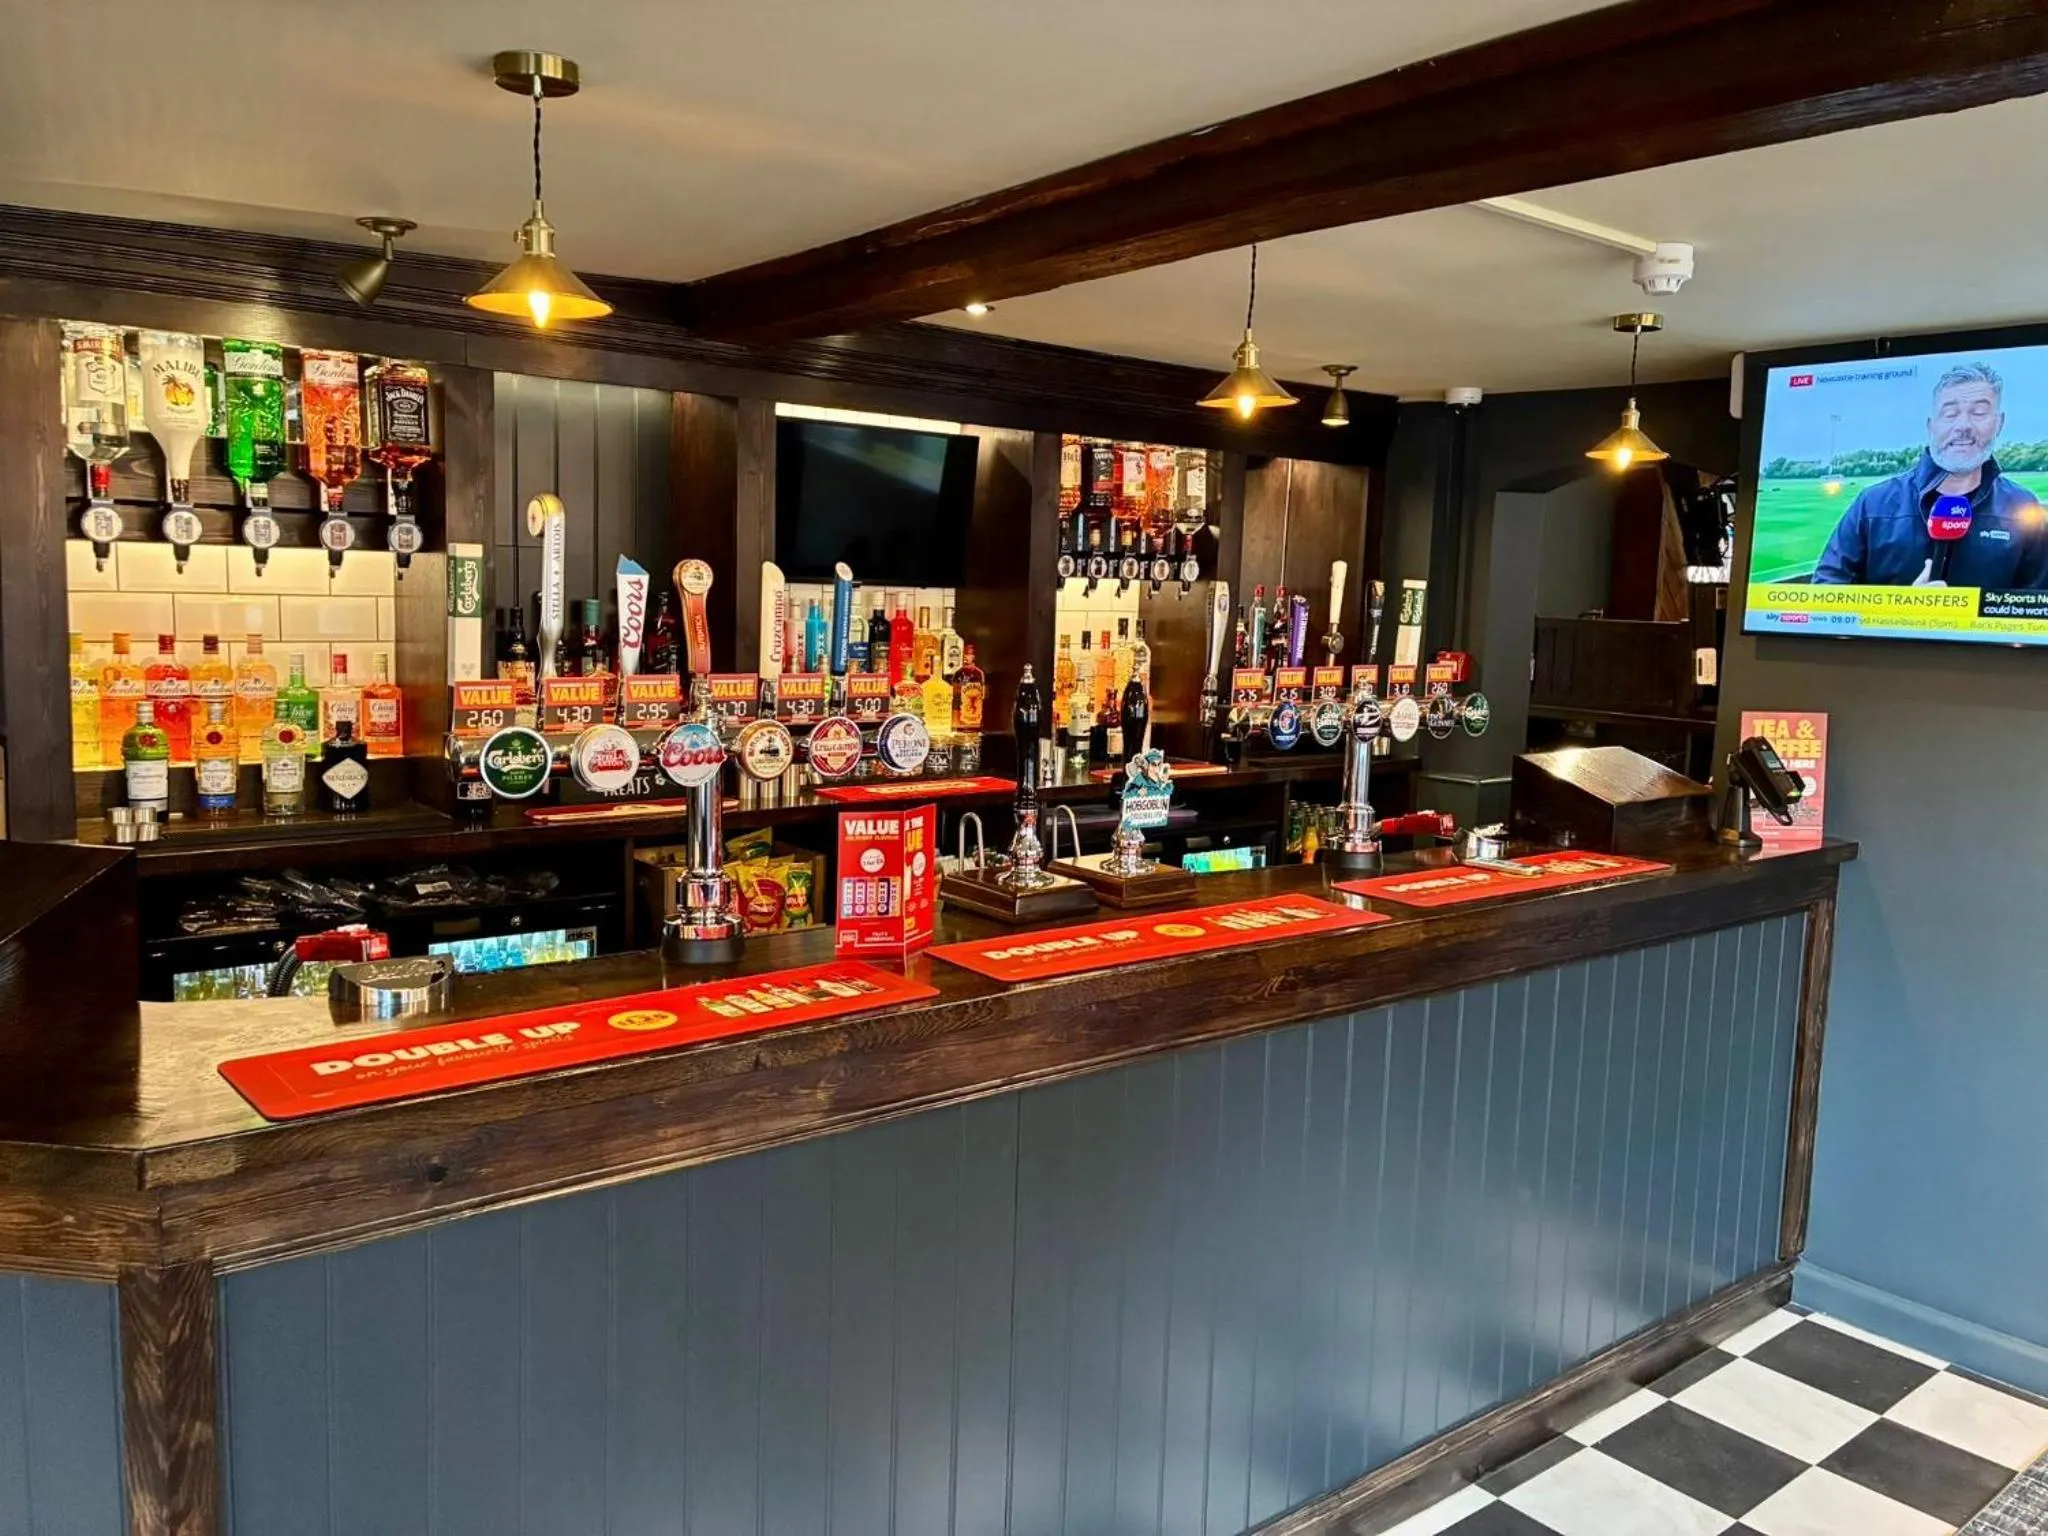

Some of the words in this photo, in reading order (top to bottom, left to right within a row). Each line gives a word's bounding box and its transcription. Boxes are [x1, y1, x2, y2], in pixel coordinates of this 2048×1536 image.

[1884, 369, 1913, 380] ground
[1951, 505, 1966, 517] sky
[552, 523, 562, 562] ARTOIS
[457, 560, 480, 614] Carlsberg
[552, 582, 561, 620] STELLA
[1767, 591, 1809, 603] GOOD
[1813, 592, 1882, 605] MORNING
[1887, 593, 1969, 608] TRANSFERS
[1985, 593, 2003, 604] Sky
[2004, 593, 2036, 604] Sports
[622, 578, 645, 649] Coors
[1984, 605, 2011, 614] could
[2012, 606, 2025, 615] be
[770, 590, 783, 663] Cruzcampo
[549, 687, 600, 701] VALUE
[628, 685, 676, 699] VALUE
[711, 684, 754, 697] VALUE
[781, 683, 821, 696] VALUE
[851, 680, 889, 693] VALUE
[461, 687, 512, 705] VALUE
[636, 703, 669, 719] 2.95
[786, 699, 815, 714] 4.30
[855, 697, 881, 713] 5.00
[466, 709, 504, 728] 2.60
[556, 706, 592, 723] 4.30
[1752, 719, 1789, 738] TEA
[1795, 720, 1815, 739] &
[814, 742, 860, 753] Cruzcampo
[892, 738, 927, 749] PERONI
[486, 750, 545, 769] Carlsberg
[661, 740, 725, 768] Coors
[1125, 799, 1169, 812] HOBGOBLIN
[845, 819, 900, 835] VALUE
[990, 936, 1103, 961] DOUBLE
[1099, 930, 1139, 941] UP
[310, 1033, 513, 1076] DOUBLE
[518, 1021, 581, 1040] UP
[356, 1070, 384, 1080] on
[387, 1061, 431, 1077] your
[437, 1044, 518, 1066] favourite
[521, 1034, 575, 1050] spirits
